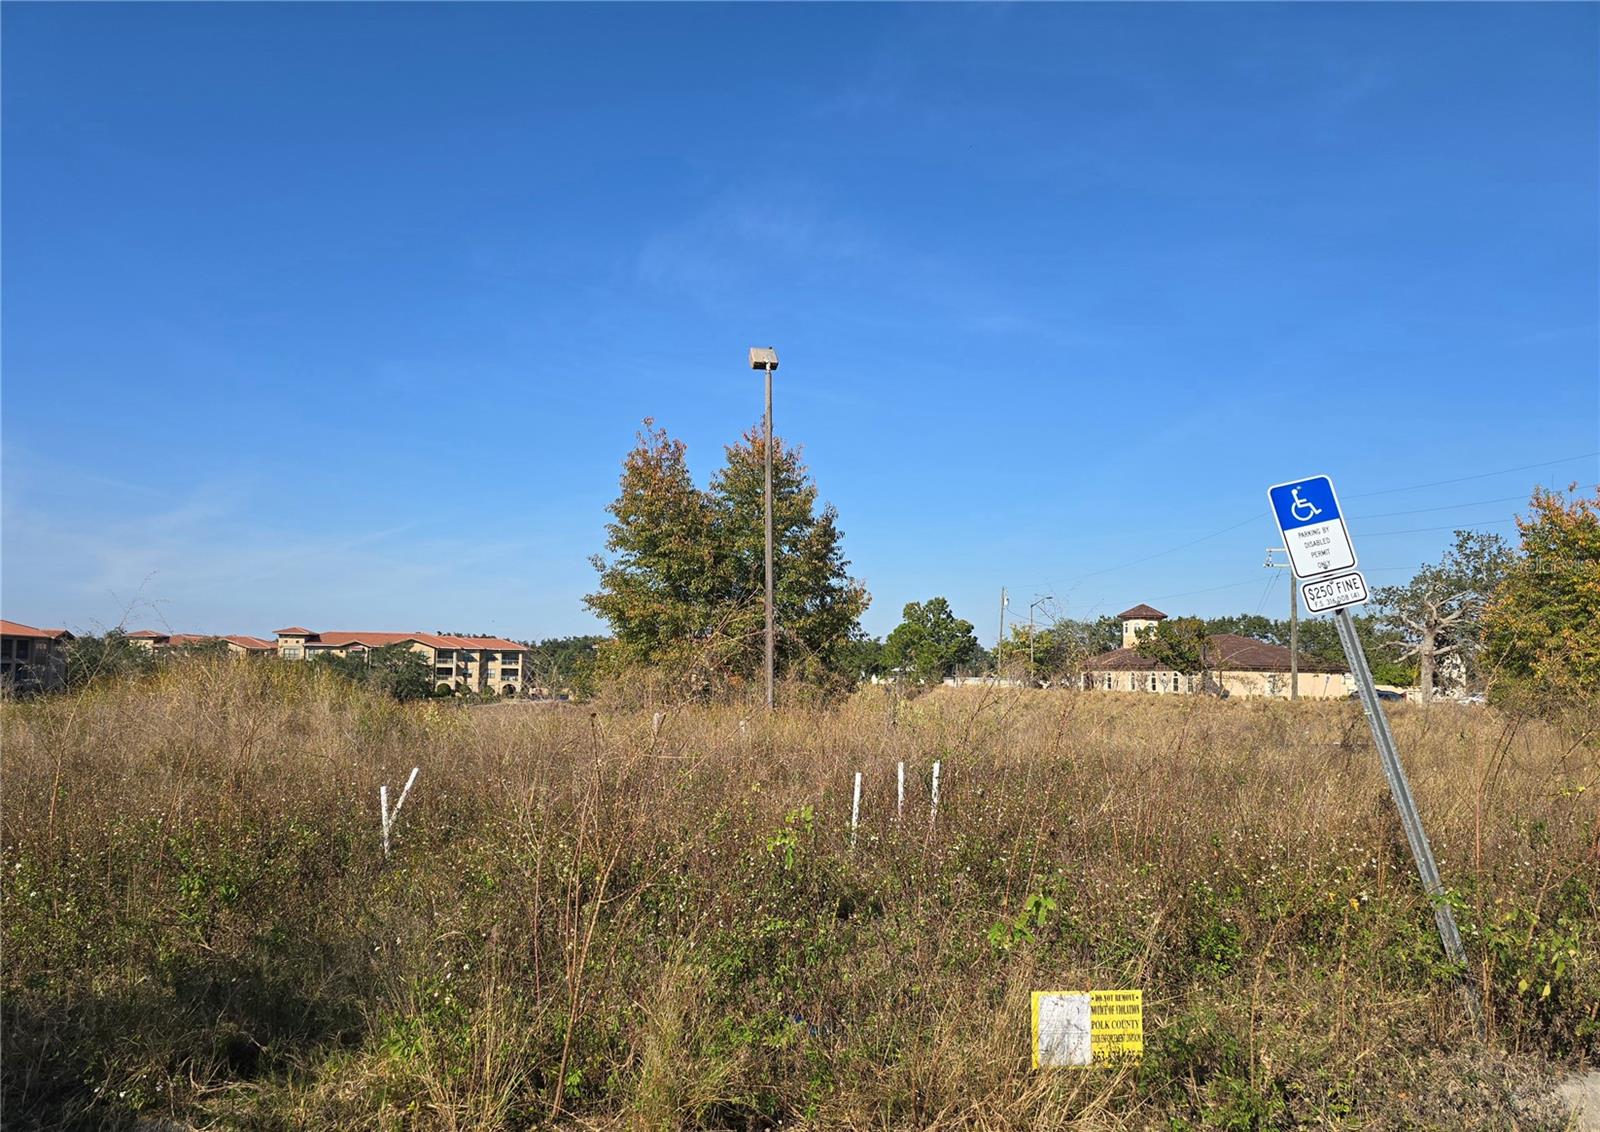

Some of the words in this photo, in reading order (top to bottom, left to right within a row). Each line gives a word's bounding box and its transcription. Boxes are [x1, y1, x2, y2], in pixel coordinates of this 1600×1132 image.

[1298, 528, 1321, 538] PARKING
[1322, 526, 1329, 534] BY
[1304, 536, 1331, 549] DISABLED
[1311, 548, 1330, 558] PERMIT
[1308, 583, 1334, 602] $250
[1335, 577, 1360, 594] FINE
[1091, 1020, 1110, 1030] POLK
[1111, 1019, 1139, 1029] COUNTY
